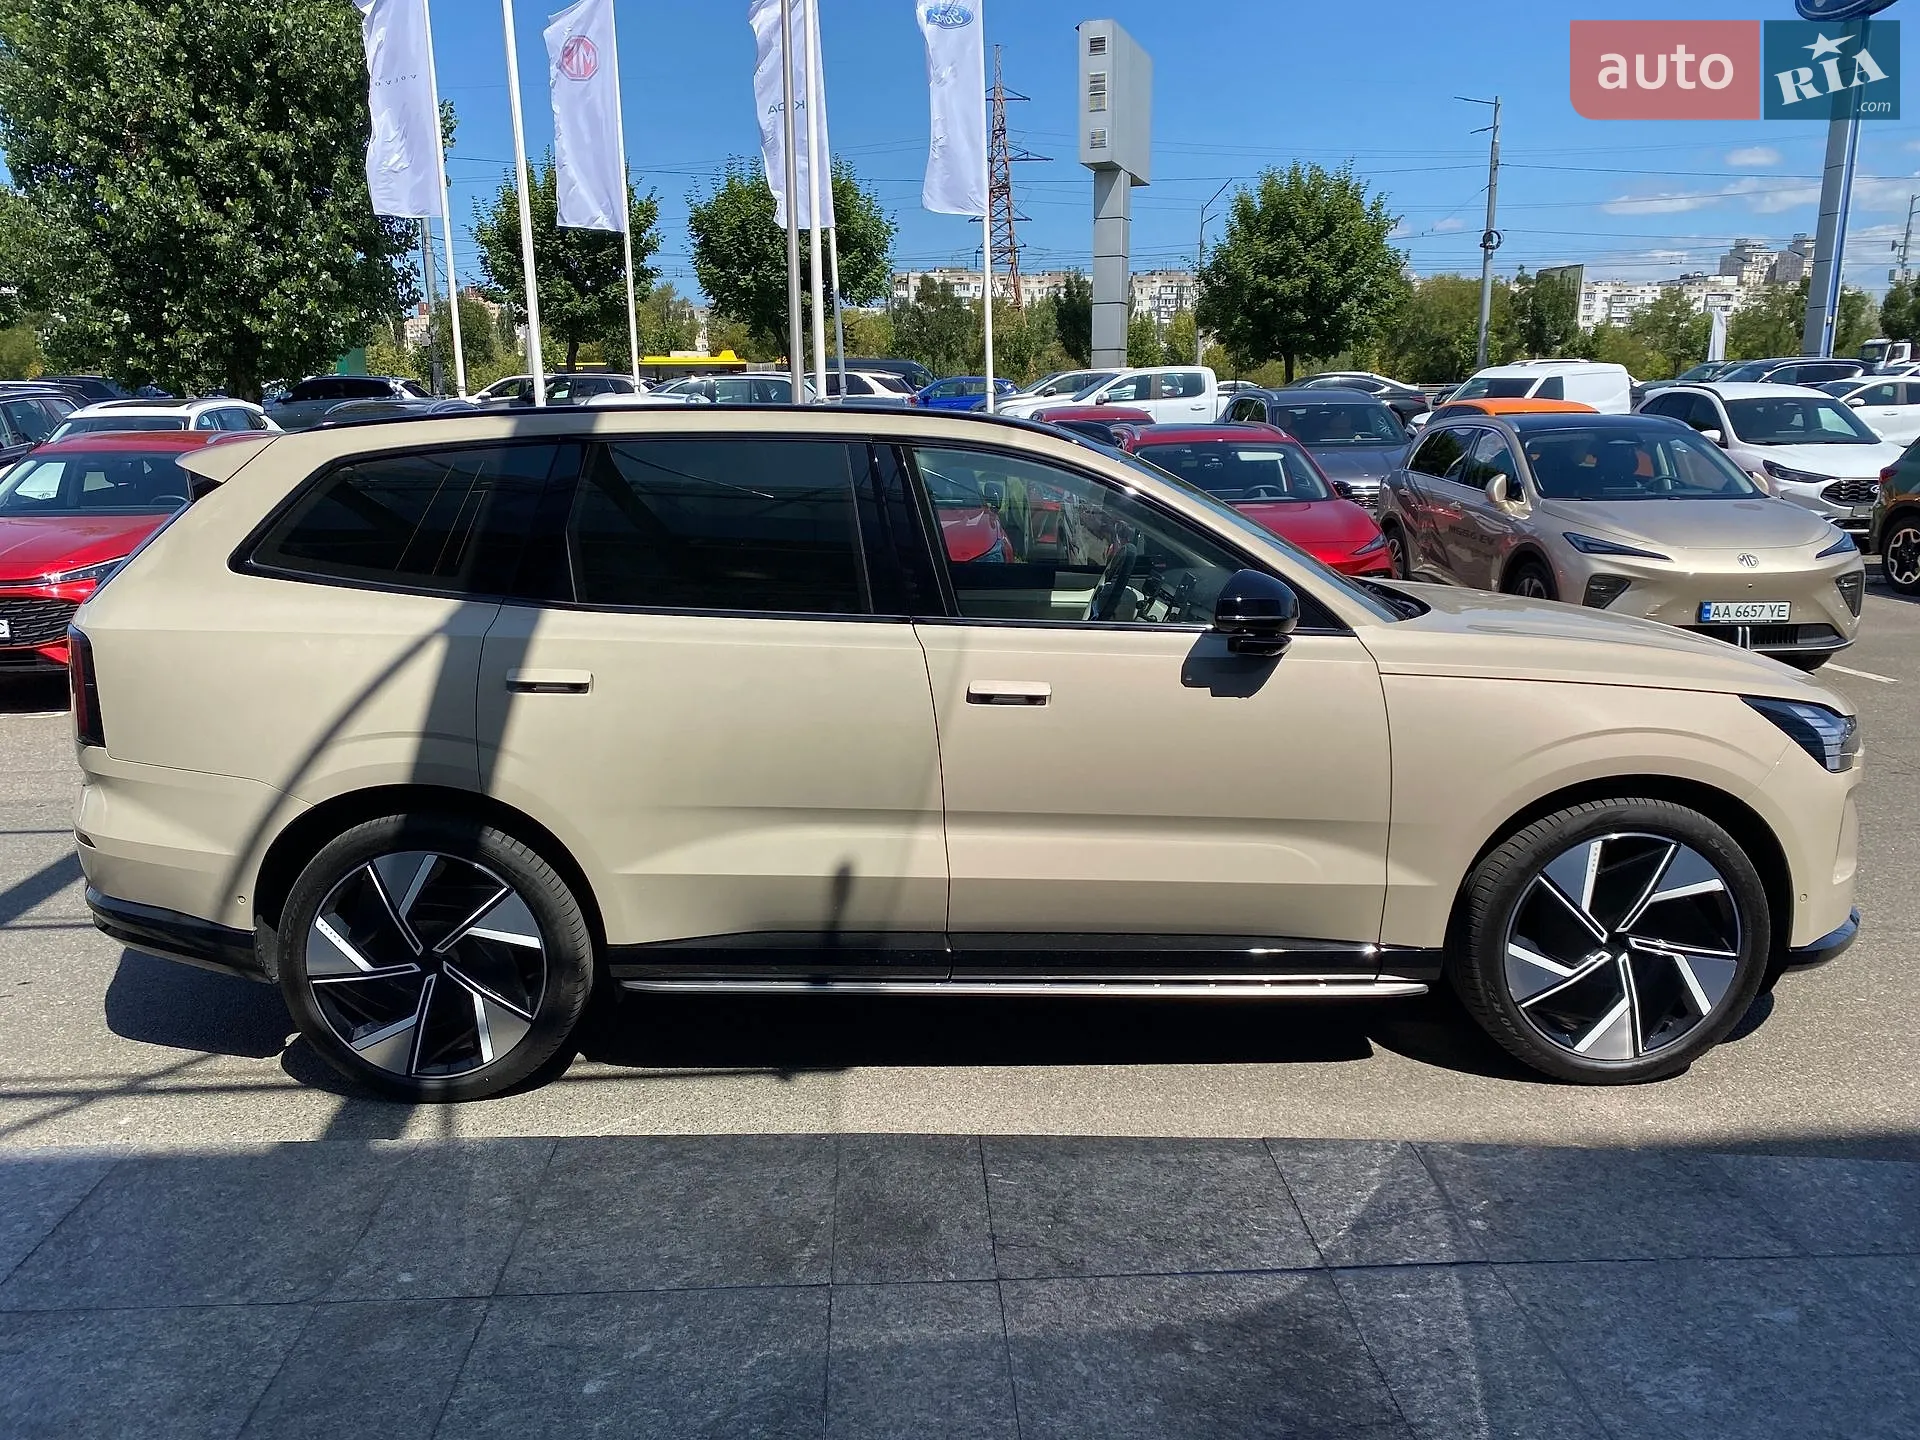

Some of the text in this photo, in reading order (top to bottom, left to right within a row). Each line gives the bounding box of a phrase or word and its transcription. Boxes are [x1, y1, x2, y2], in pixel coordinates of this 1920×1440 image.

[1738, 553, 1759, 568] MG
[1711, 605, 1731, 618] AA
[1735, 604, 1766, 618] 6657
[1769, 604, 1787, 618] YE
